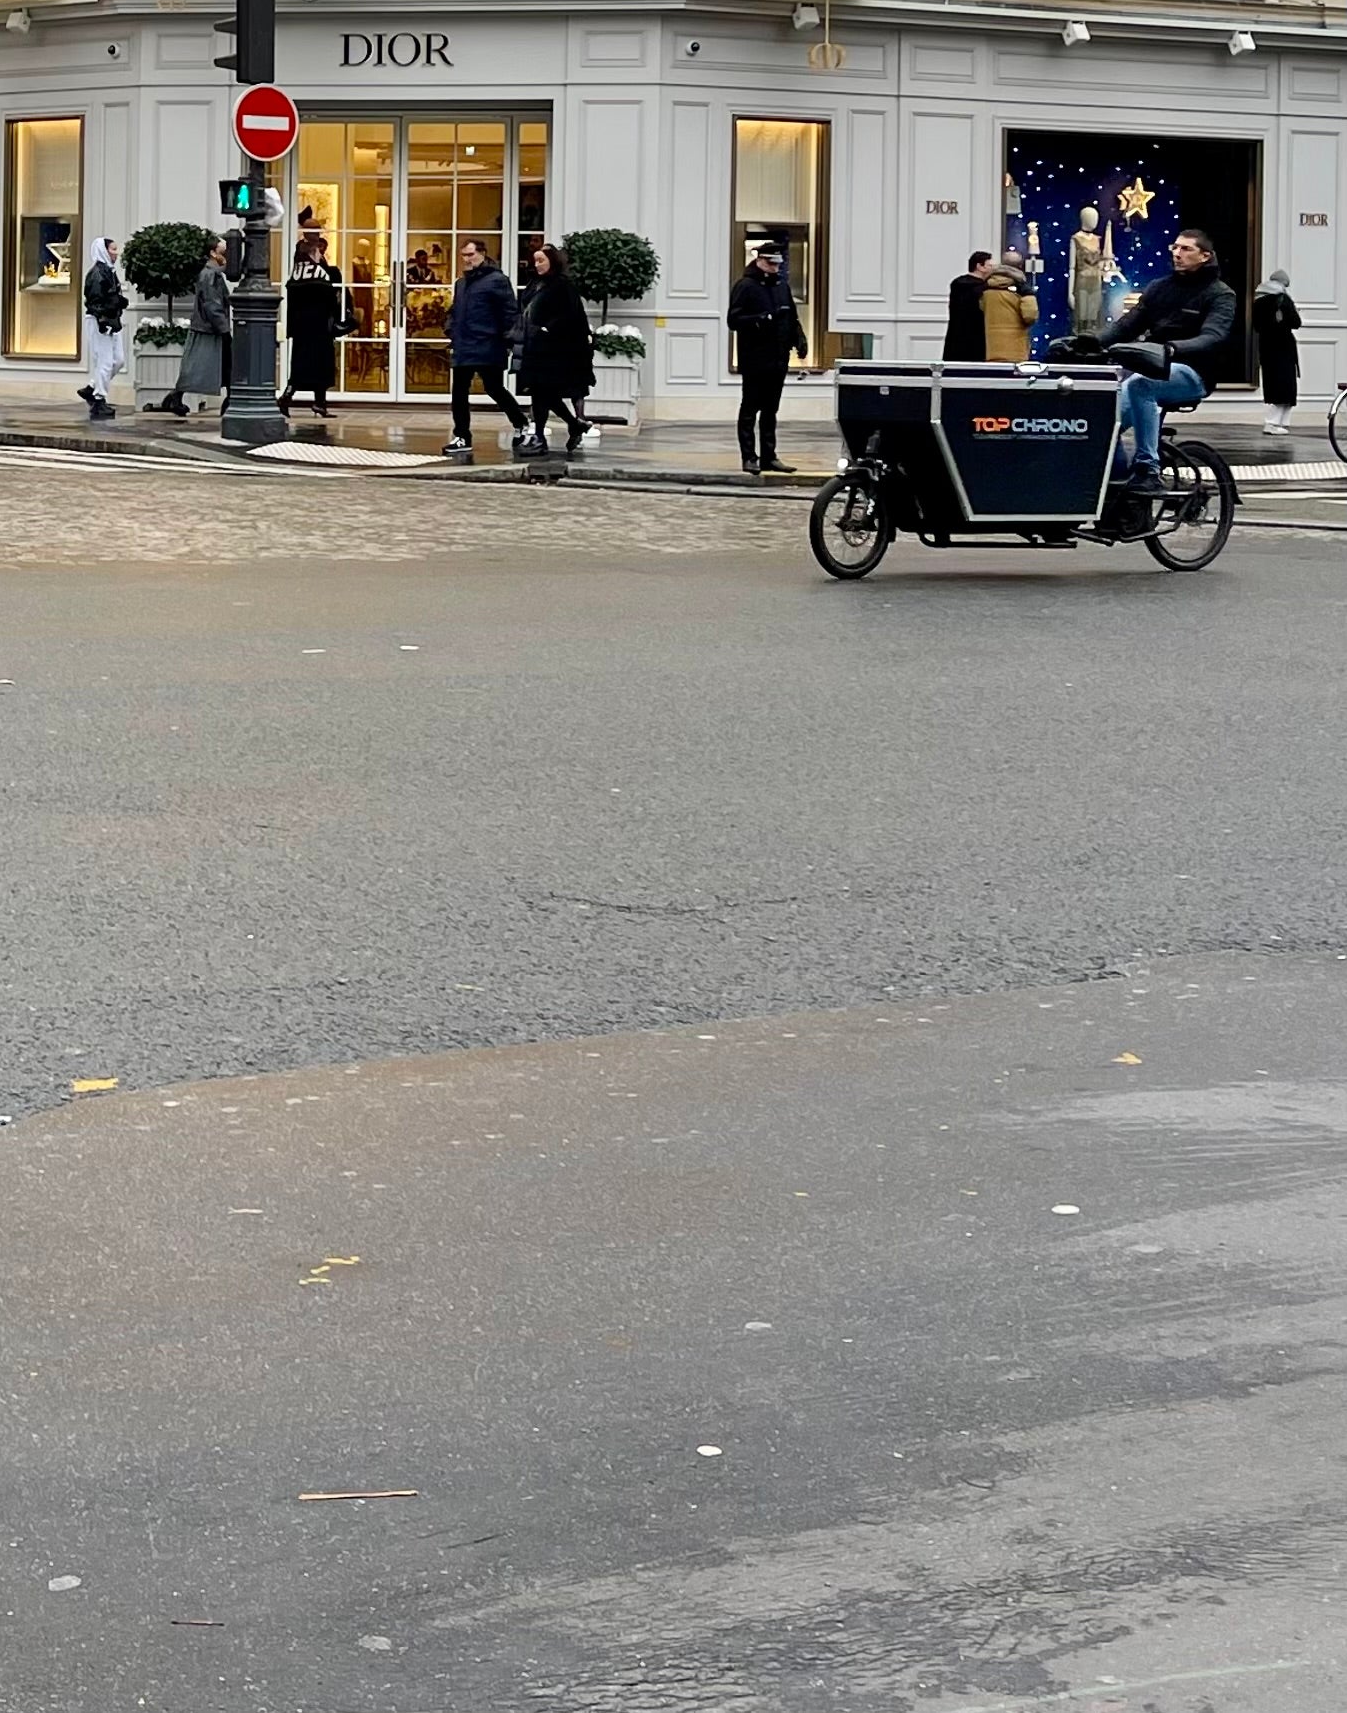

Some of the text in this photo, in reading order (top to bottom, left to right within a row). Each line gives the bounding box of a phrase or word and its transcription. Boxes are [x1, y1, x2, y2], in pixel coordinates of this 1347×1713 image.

[339, 32, 454, 67] DIOR
[926, 200, 959, 214] DIOR
[1299, 213, 1328, 226] DIOR
[972, 417, 1088, 433] TOP CHRONO
